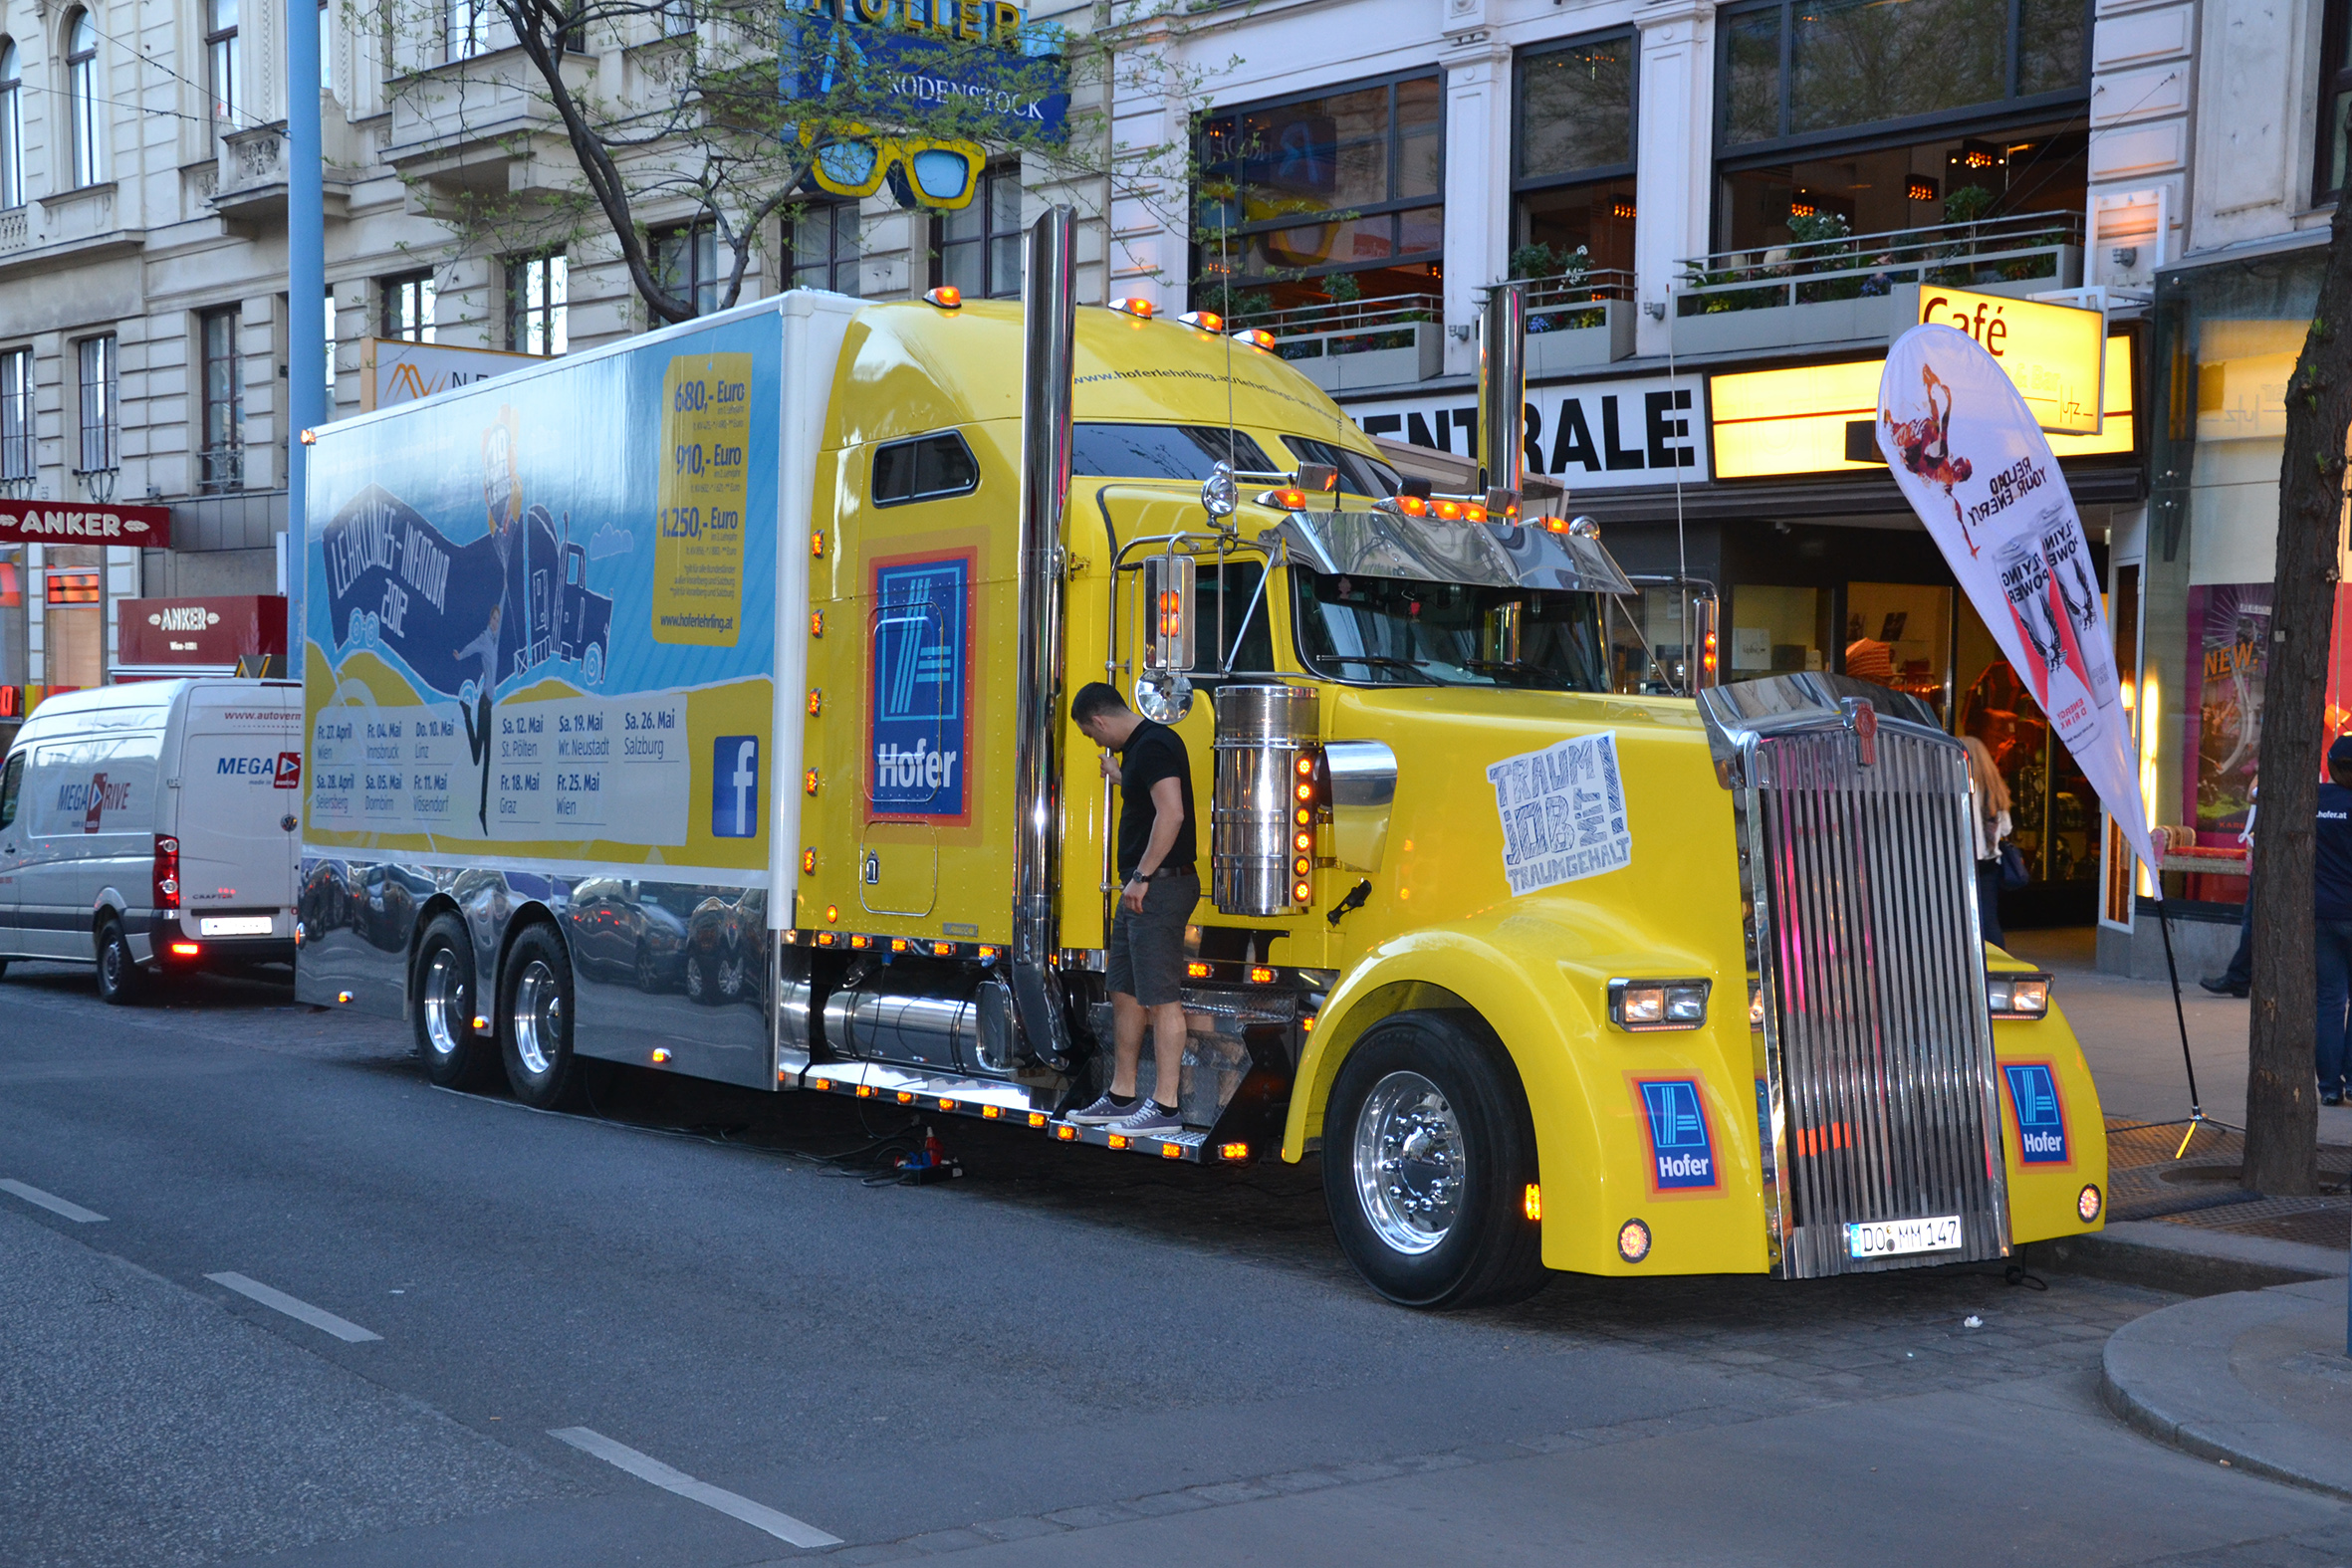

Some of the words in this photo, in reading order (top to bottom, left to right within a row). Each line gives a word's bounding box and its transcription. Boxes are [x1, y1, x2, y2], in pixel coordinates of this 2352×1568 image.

[1923, 297, 2006, 356] Café
[674, 380, 714, 414] 680,-
[717, 380, 745, 403] Euro
[1351, 389, 1695, 474] NTRALE
[676, 444, 711, 478] 910,-
[714, 444, 742, 466] Euro
[20, 510, 120, 537] ANKER
[660, 507, 708, 541] 1.250,-
[711, 507, 738, 530] Euro
[380, 578, 408, 638] 2012
[160, 607, 206, 631] ANKER
[660, 612, 734, 633] www.hoferlehrling.at
[2204, 640, 2258, 677] NEW.
[376, 724, 387, 738] 04.
[389, 721, 402, 738] Mai
[415, 722, 428, 737] Do.
[429, 722, 439, 737] 10.
[440, 719, 455, 737] Mai
[503, 718, 515, 734] Sa.
[516, 718, 527, 734] 12.
[528, 715, 544, 734] Mai
[559, 716, 572, 733] Sa.
[574, 715, 586, 732] 19.
[587, 712, 603, 732] Mai
[624, 712, 638, 730] Sa.
[640, 712, 655, 730] 26.
[657, 709, 675, 729] Mai
[336, 723, 353, 743] April
[318, 746, 333, 760] Wien
[366, 745, 399, 759] Innsbruck
[415, 743, 429, 759] Linz
[501, 741, 511, 758] St.
[513, 740, 538, 757] Pölten
[559, 740, 570, 756] Wr.
[572, 737, 609, 756] Neustadt
[624, 736, 664, 760] Salzburg
[217, 758, 274, 775] MEGA
[879, 738, 957, 787] Hofer
[1489, 739, 1595, 807] TRAUM
[317, 775, 326, 789] Sa.
[339, 774, 354, 793] April
[365, 775, 376, 789] Sa.
[389, 773, 402, 789] Mai
[423, 776, 432, 789] 11.
[433, 773, 448, 790] Mai
[501, 775, 510, 790] Fr.
[512, 775, 523, 790] 18.
[525, 773, 540, 790] Mai
[557, 775, 567, 791] Fr.
[569, 775, 582, 791] 25.
[584, 773, 599, 791] Mai
[500, 797, 517, 813] Graz
[556, 797, 577, 815] Wien
[1508, 836, 1630, 892] TRAUMGEHALT
[2022, 1131, 2063, 1154] Hofer
[1659, 1153, 1709, 1178] Hofer
[1862, 1227, 1886, 1252] DO
[1898, 1225, 1922, 1248] MM
[1927, 1221, 1957, 1246] 147
